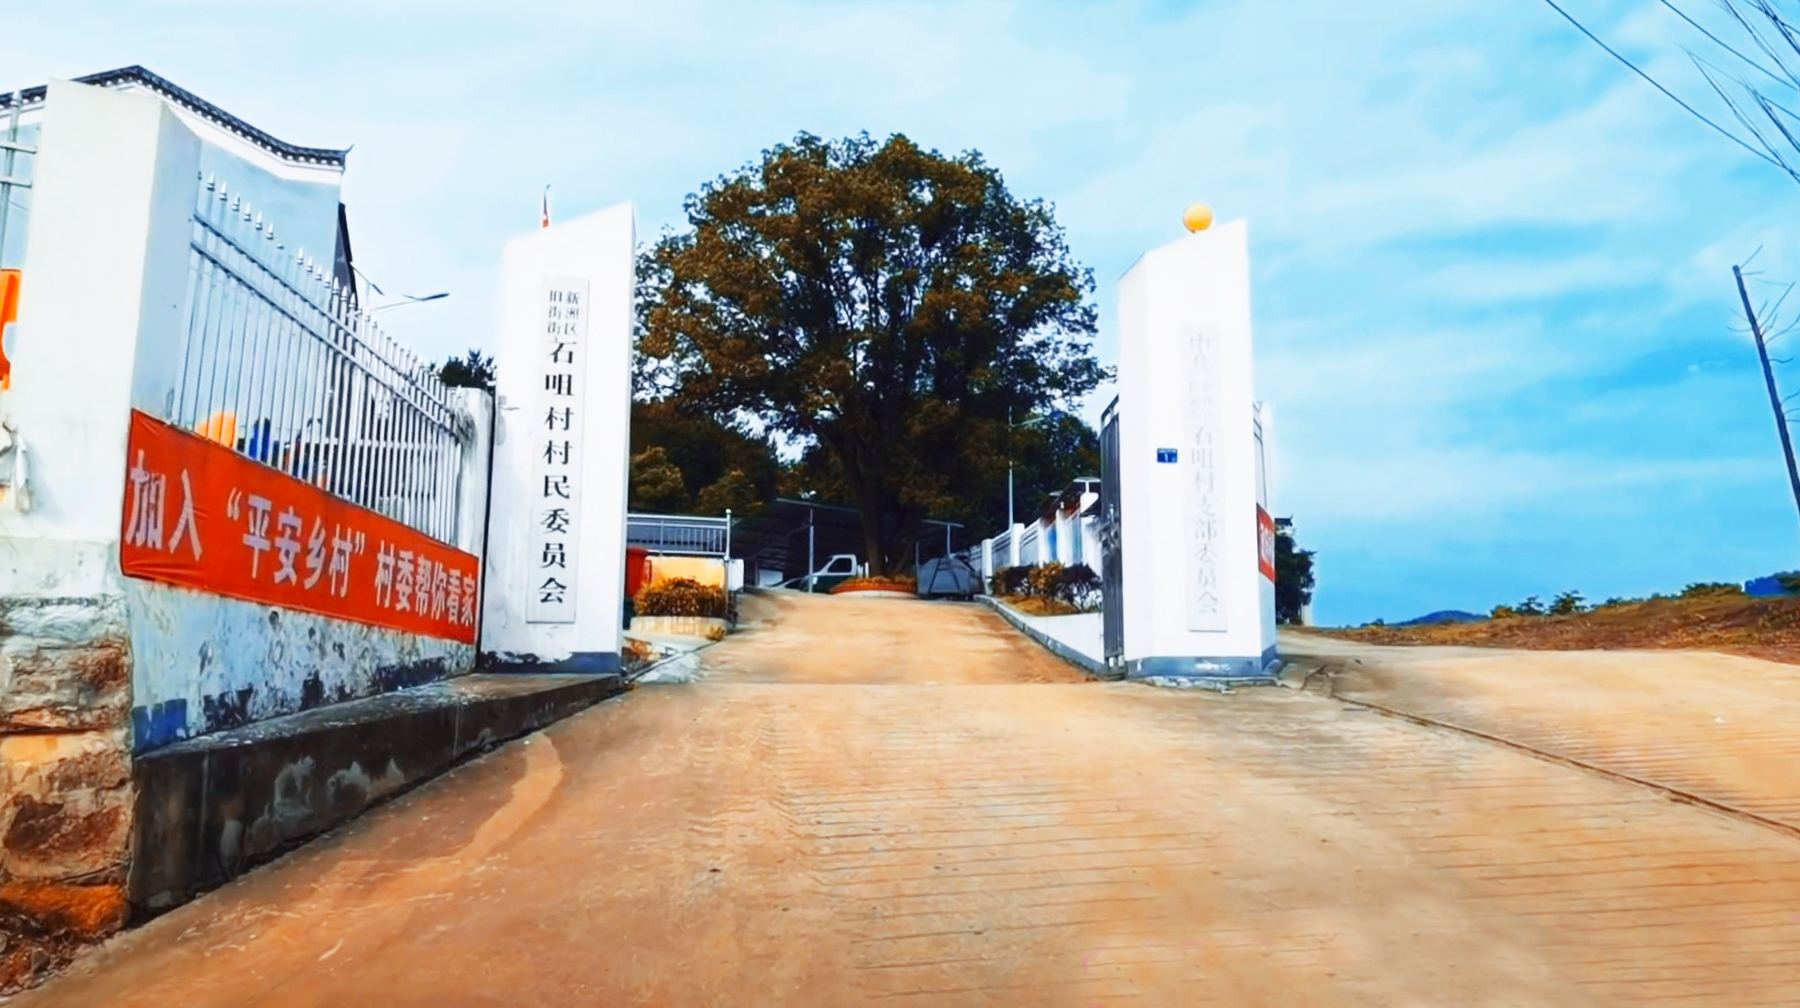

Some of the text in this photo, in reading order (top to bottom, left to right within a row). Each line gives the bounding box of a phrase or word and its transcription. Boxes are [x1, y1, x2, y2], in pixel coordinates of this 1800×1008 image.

[125, 449, 203, 563] 加入
[374, 539, 476, 627] 村委帮你看家
[538, 341, 576, 604] 石咀村村民委员会
